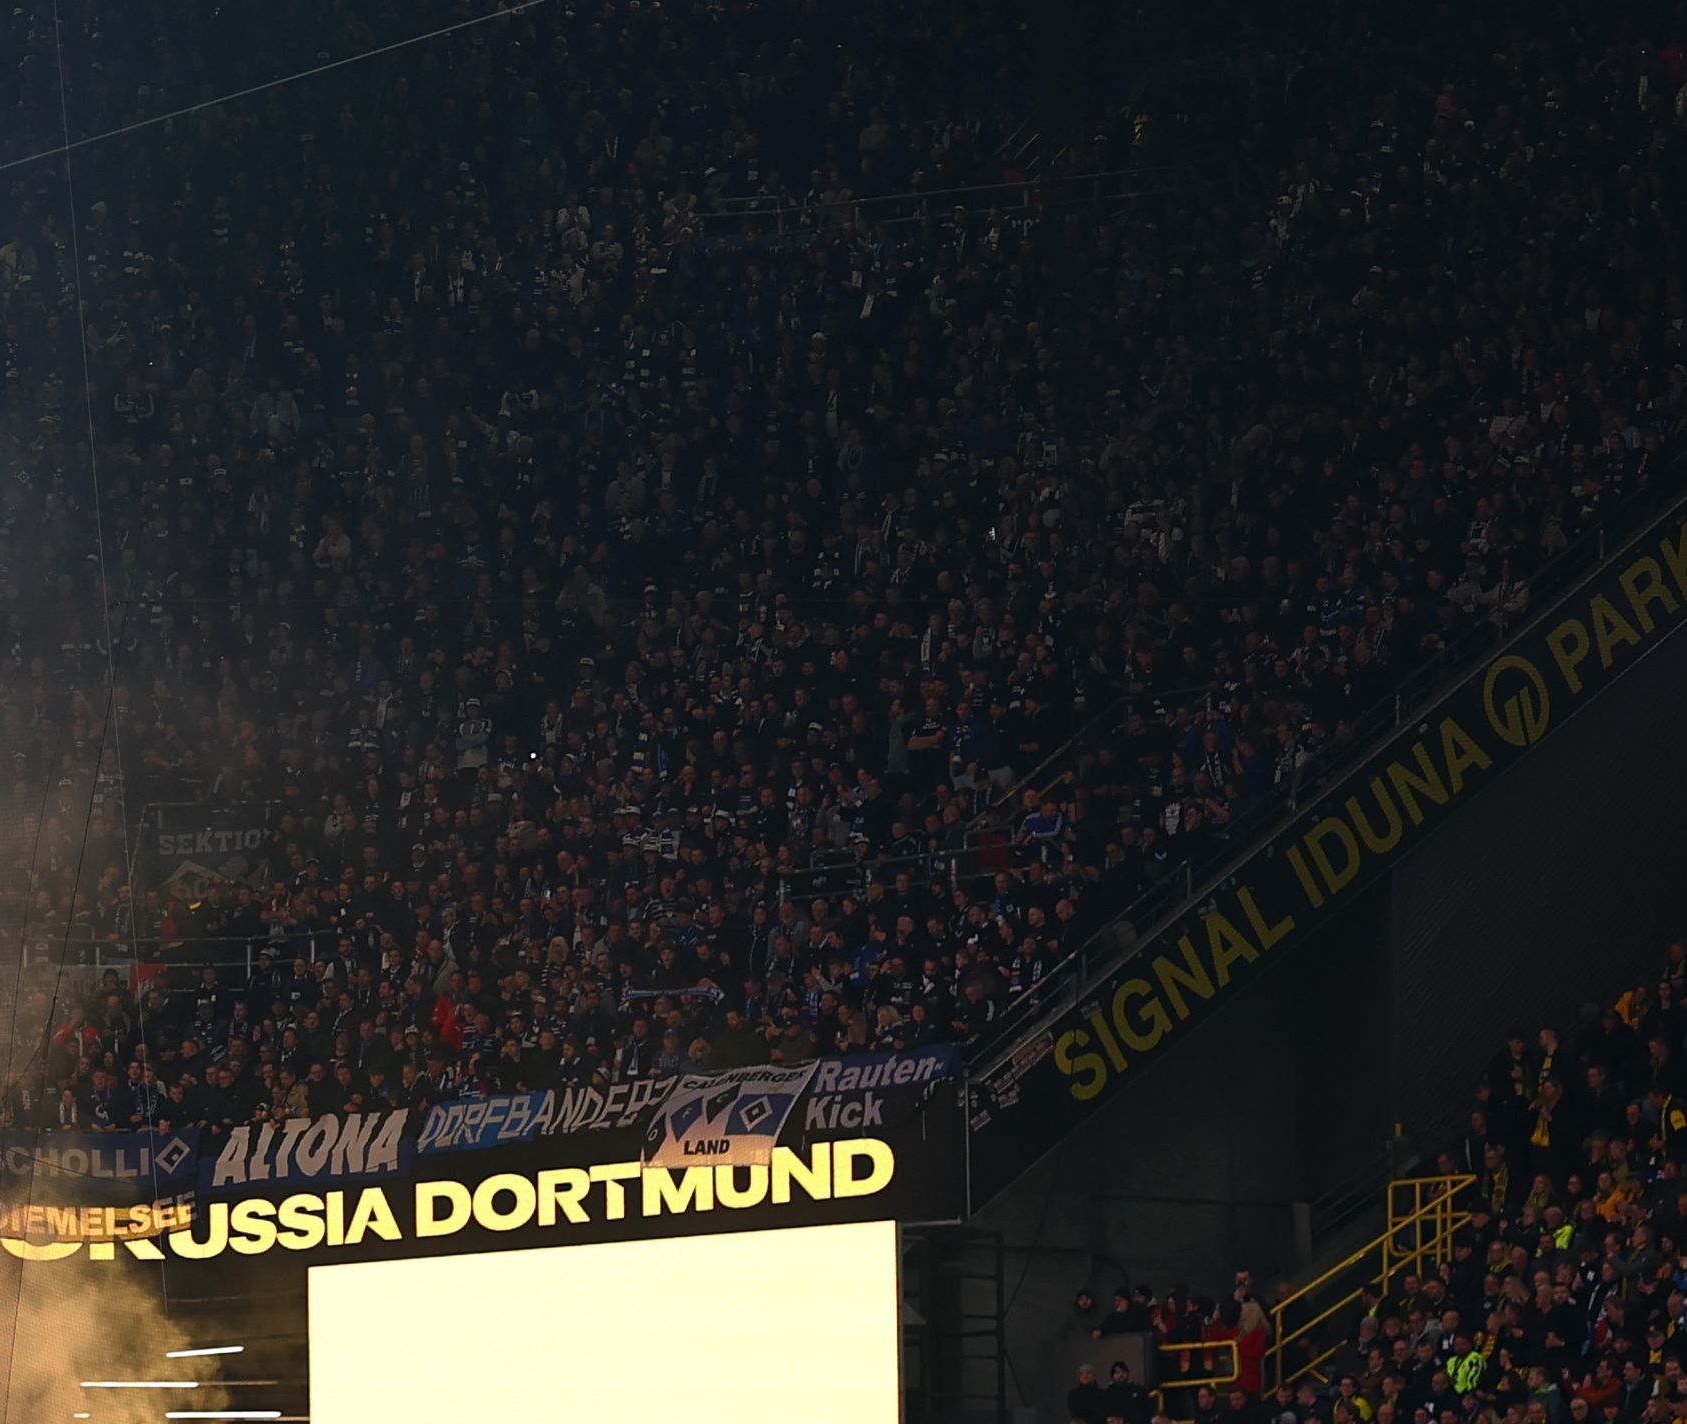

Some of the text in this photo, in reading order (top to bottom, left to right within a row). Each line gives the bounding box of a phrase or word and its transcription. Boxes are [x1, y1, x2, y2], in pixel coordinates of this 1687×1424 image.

[1054, 886, 1296, 1100] SIGNAL
[1286, 716, 1494, 908] IDUNA
[212, 1107, 410, 1187] ALTONA
[683, 1139, 730, 1156] LAND
[805, 1092, 884, 1131] Kick
[415, 1137, 895, 1238] DORTMUND
